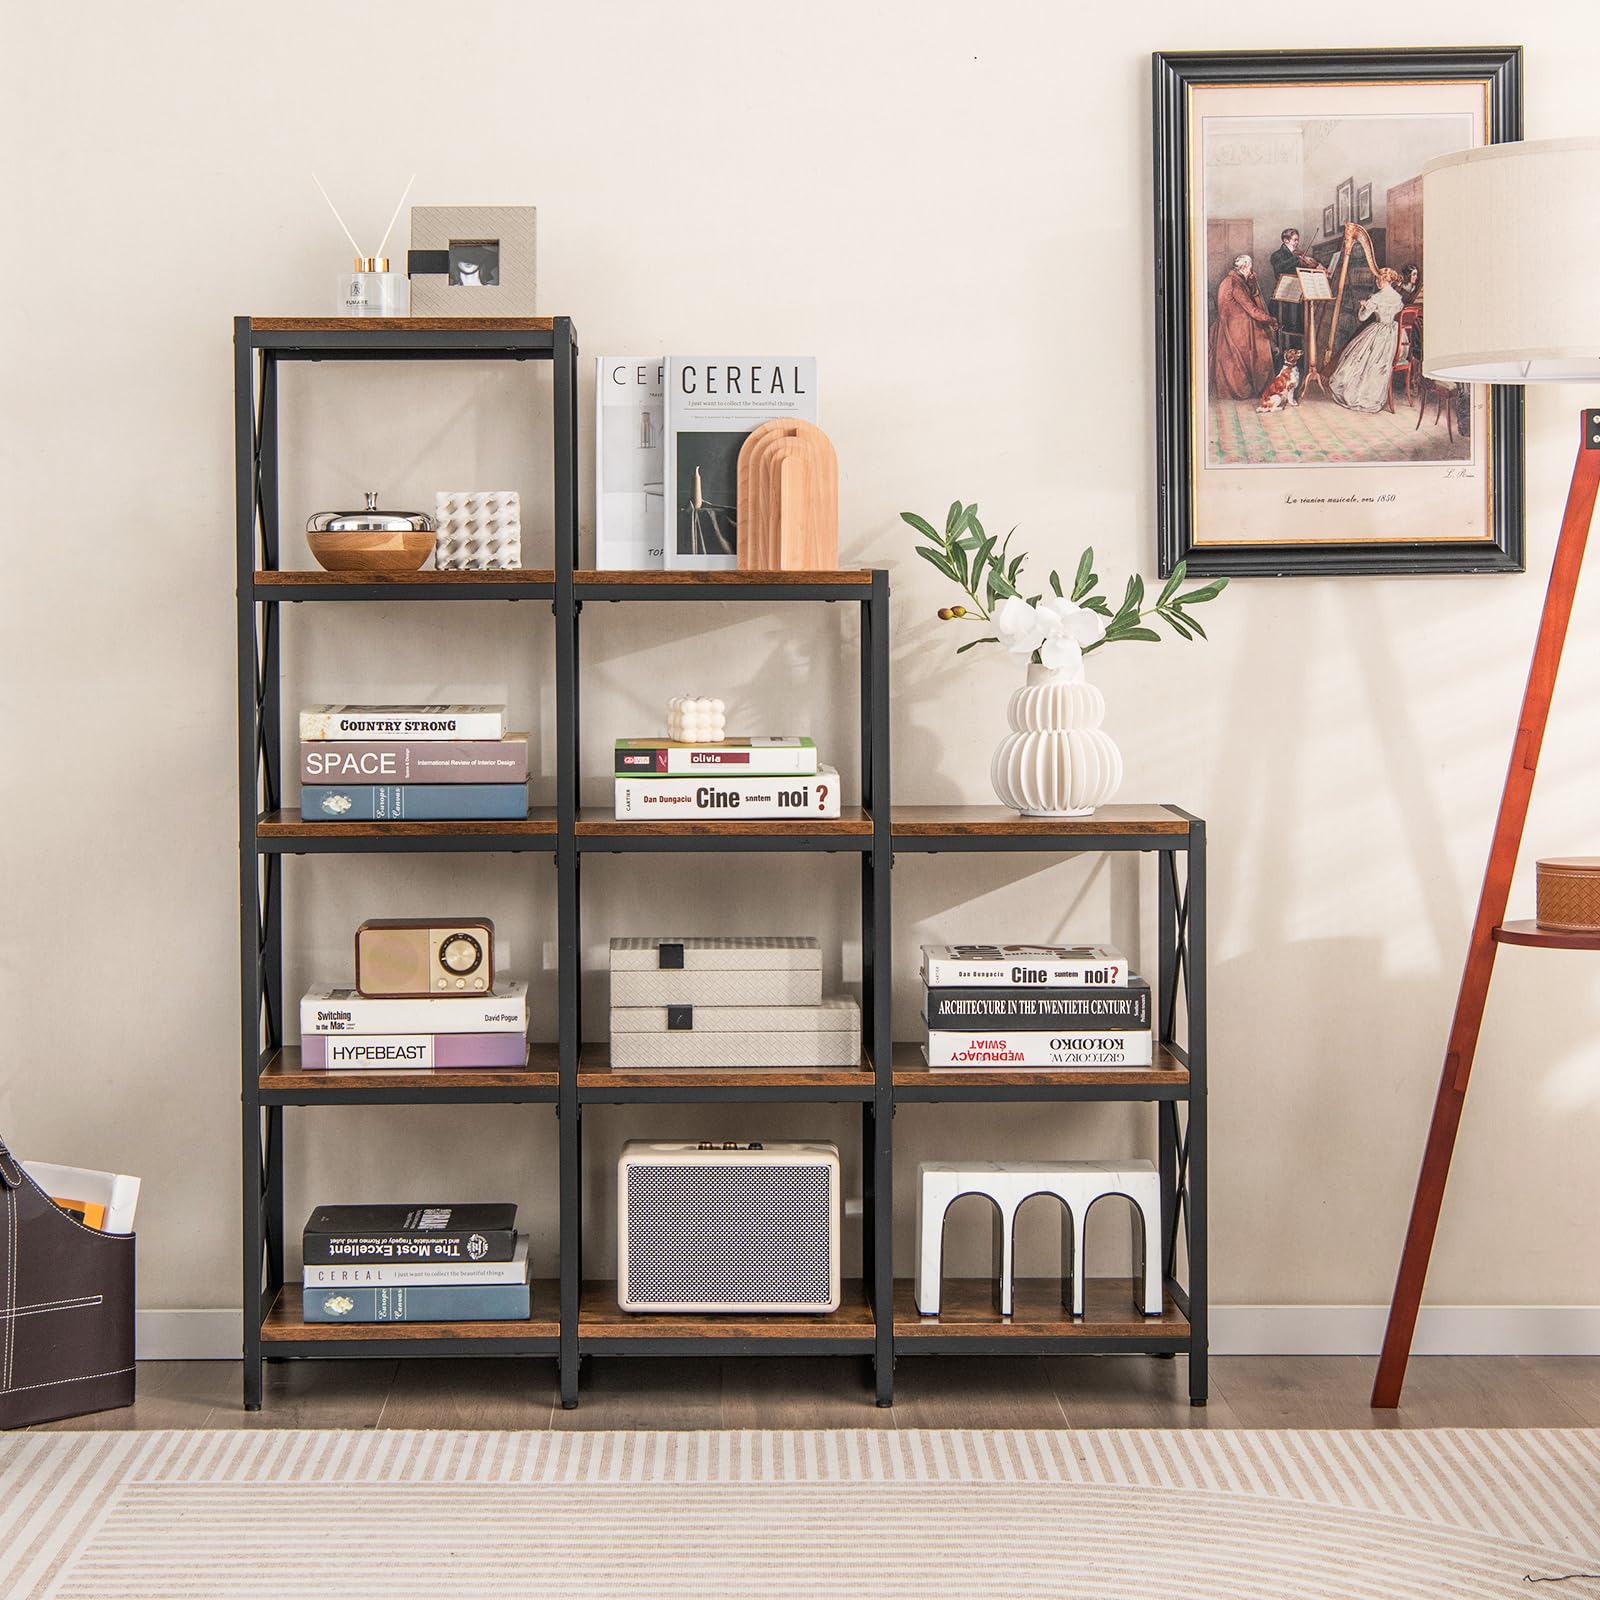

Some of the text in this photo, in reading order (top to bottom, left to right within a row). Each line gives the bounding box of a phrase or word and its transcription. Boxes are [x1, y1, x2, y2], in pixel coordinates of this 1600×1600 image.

[682, 366, 805, 394] CEREAL
[1286, 496, 1297, 504] La
[1377, 494, 1396, 502] 1850
[340, 719, 456, 732] COUNTRY STRONG
[306, 753, 396, 774] SPACE
[692, 753, 721, 763] olivia
[376, 787, 387, 819] Europe
[643, 795, 658, 803] Dan
[696, 787, 740, 808] Cine
[778, 786, 808, 807] noi
[816, 785, 828, 811] ?
[1011, 967, 1048, 984] Cine
[938, 1000, 1132, 1015] ARCHITECYURE IN THE TWENTIETH CENTURY
[317, 1011, 352, 1021] Switching
[485, 1014, 518, 1023] David Pogue
[330, 1021, 345, 1030] Mac
[969, 1040, 1007, 1050] ŚWIAT
[1050, 1039, 1124, 1050] KOŁODKO
[333, 1046, 426, 1060] HYPEBEAST
[1065, 1053, 1125, 1062] GRZEGORZ
[329, 1245, 460, 1257] The Most Excellent
[318, 1270, 382, 1281] CEREAL
[378, 1288, 389, 1320] Europe
